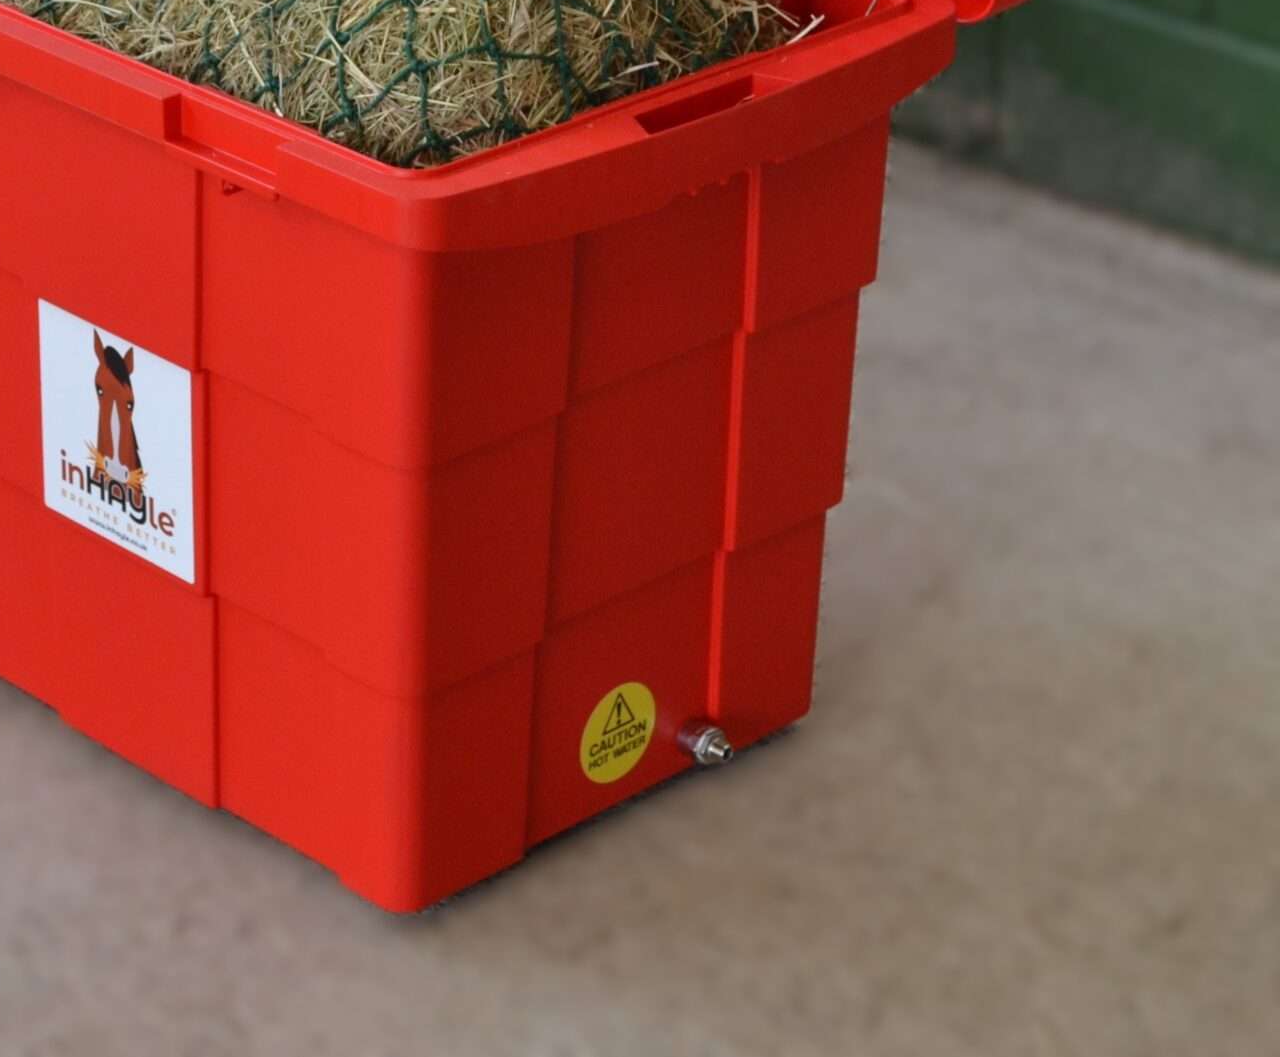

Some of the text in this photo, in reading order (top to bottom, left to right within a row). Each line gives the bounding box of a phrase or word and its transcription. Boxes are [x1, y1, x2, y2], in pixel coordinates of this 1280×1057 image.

[588, 734, 647, 772] HOT WATER
[589, 719, 647, 757] CAUTION
